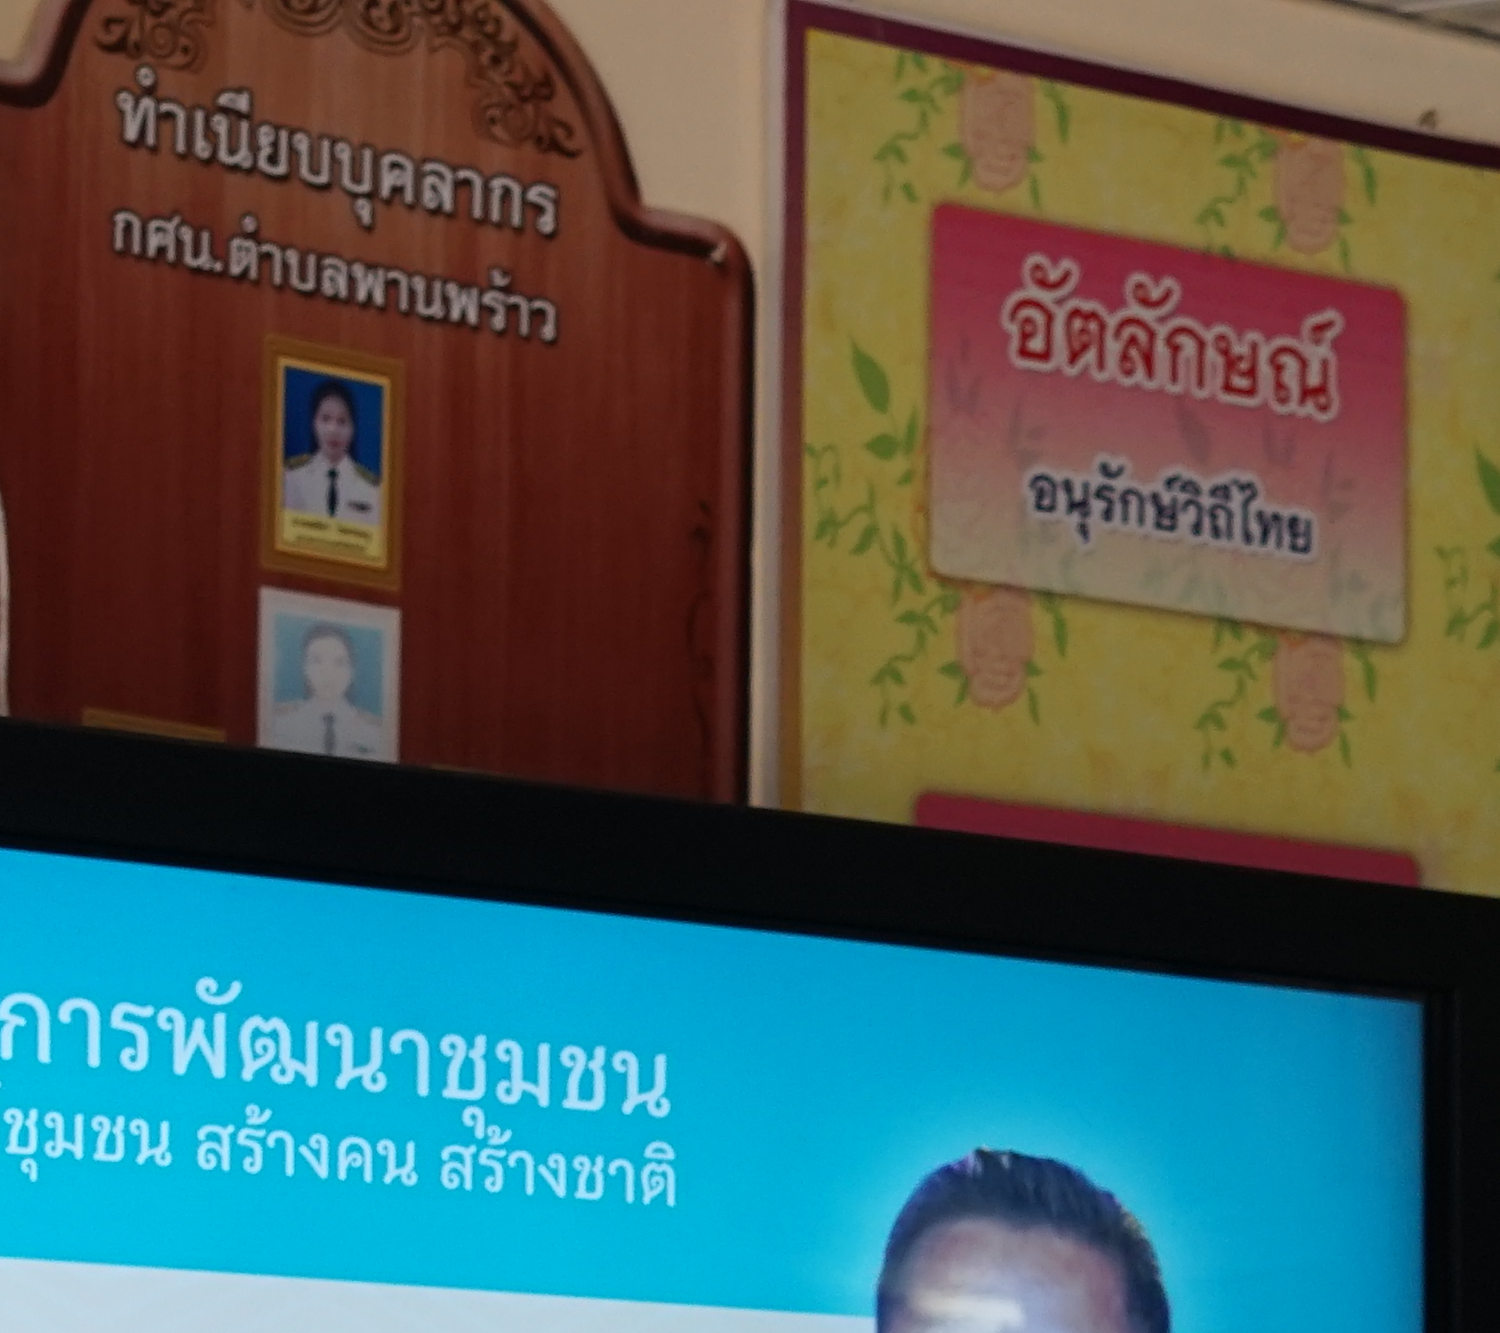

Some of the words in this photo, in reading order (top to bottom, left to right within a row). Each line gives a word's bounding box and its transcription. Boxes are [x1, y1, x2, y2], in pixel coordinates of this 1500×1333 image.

[116, 66, 560, 236] ทำเนียบบุคลากร
[112, 206, 559, 344] กศน.ตำบลพานพร้าว
[1002, 254, 1343, 422] อัตลักษณ์
[1027, 458, 1316, 560] อนุรักษ์วิถีไทย
[195, 1103, 417, 1187] สร้างคน
[438, 1125, 677, 1207] สร้างชาติ
